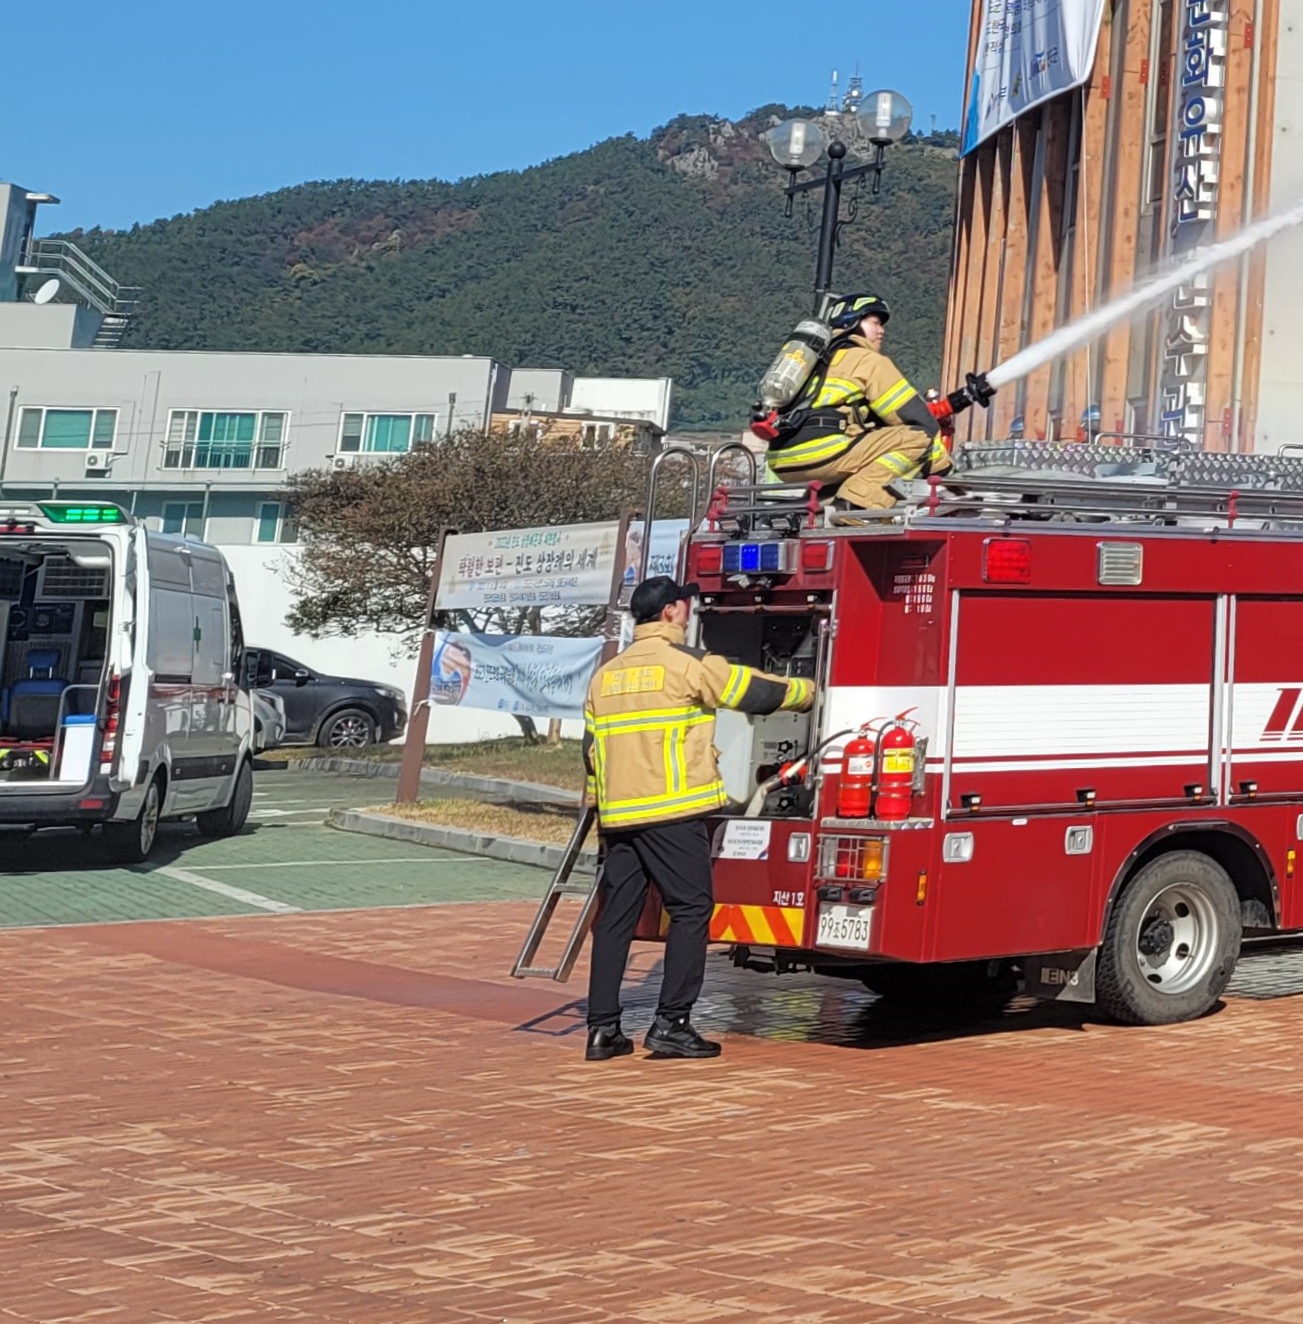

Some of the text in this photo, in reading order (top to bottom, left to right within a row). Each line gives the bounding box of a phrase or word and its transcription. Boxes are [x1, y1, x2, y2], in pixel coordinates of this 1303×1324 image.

[515, 552, 533, 575] 진도
[536, 549, 574, 574] 상장례의
[576, 547, 599, 570] 세계
[820, 916, 869, 942] 99조5783
